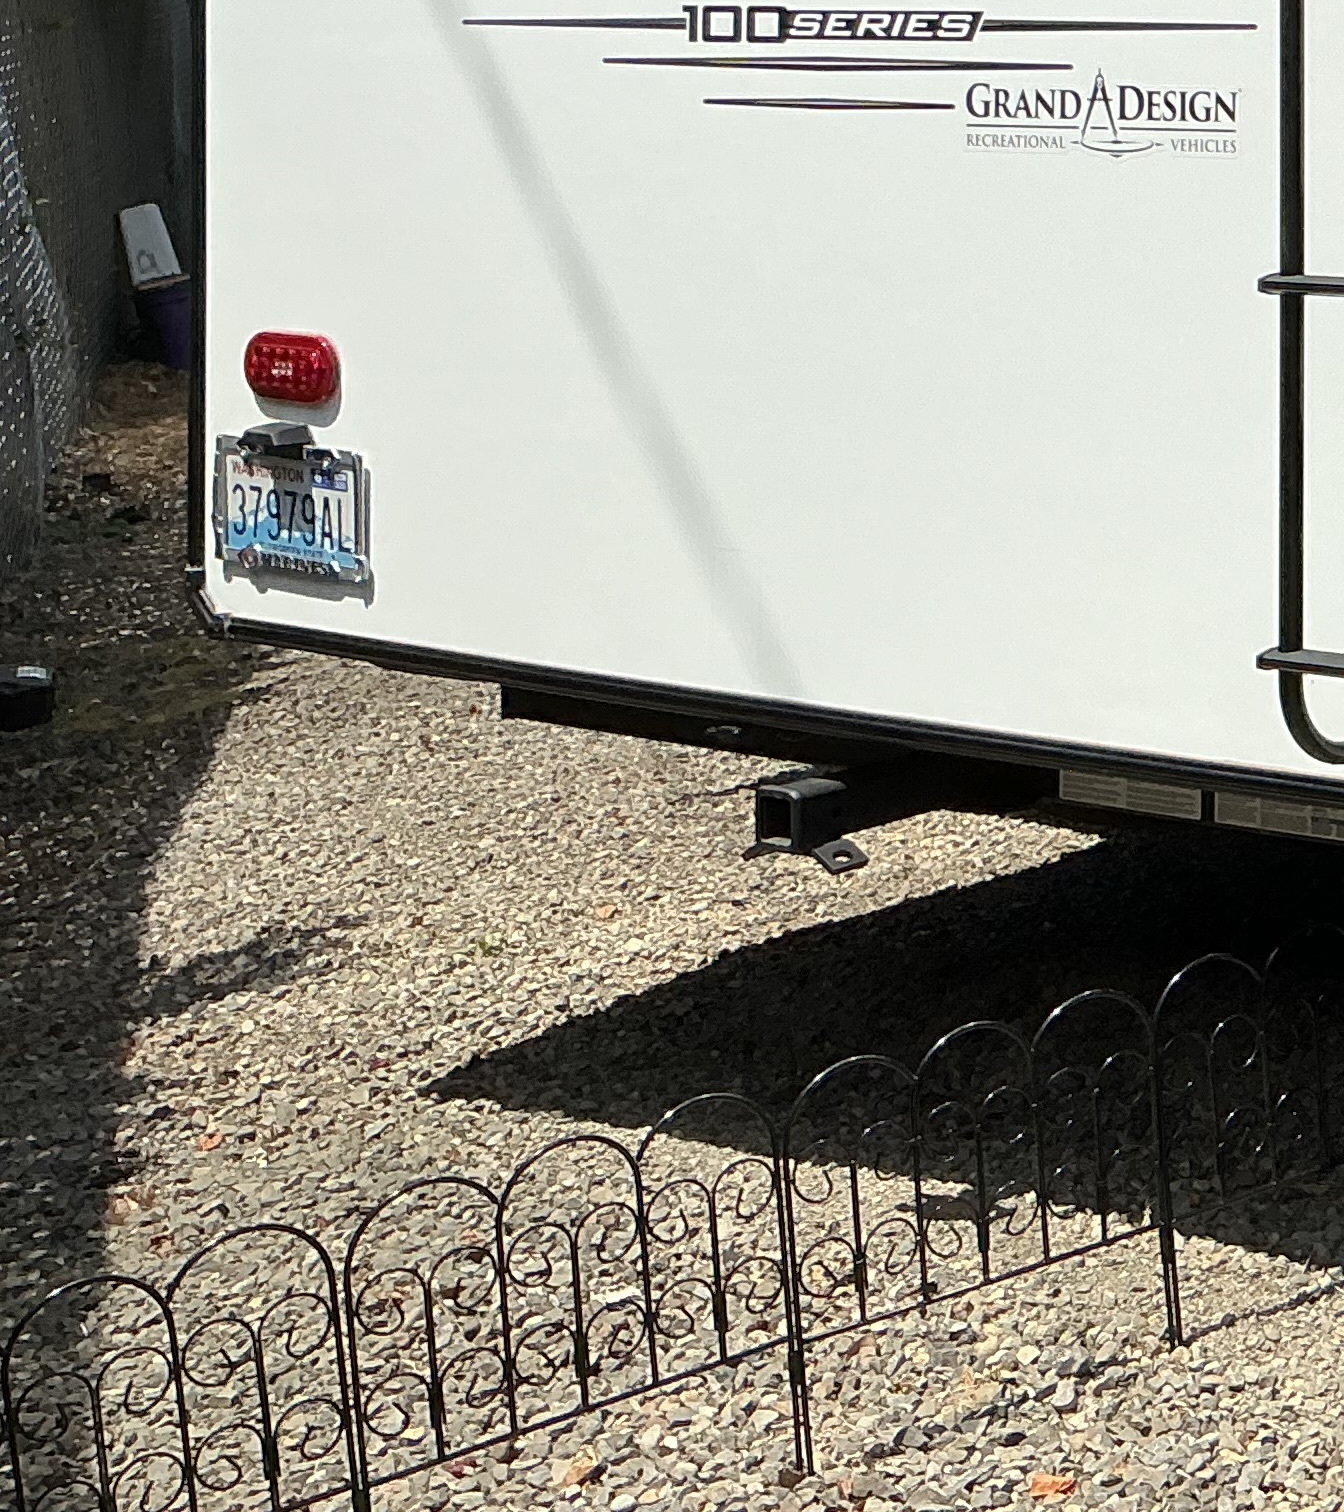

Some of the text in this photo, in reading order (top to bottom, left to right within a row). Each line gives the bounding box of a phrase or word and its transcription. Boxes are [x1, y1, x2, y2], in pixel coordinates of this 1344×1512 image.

[788, 11, 984, 42] SERIES
[966, 83, 1237, 123] GRAND DESIGN
[966, 134, 1237, 153] RECREATIONAL VEHICLES
[232, 483, 353, 554] 37979AL
